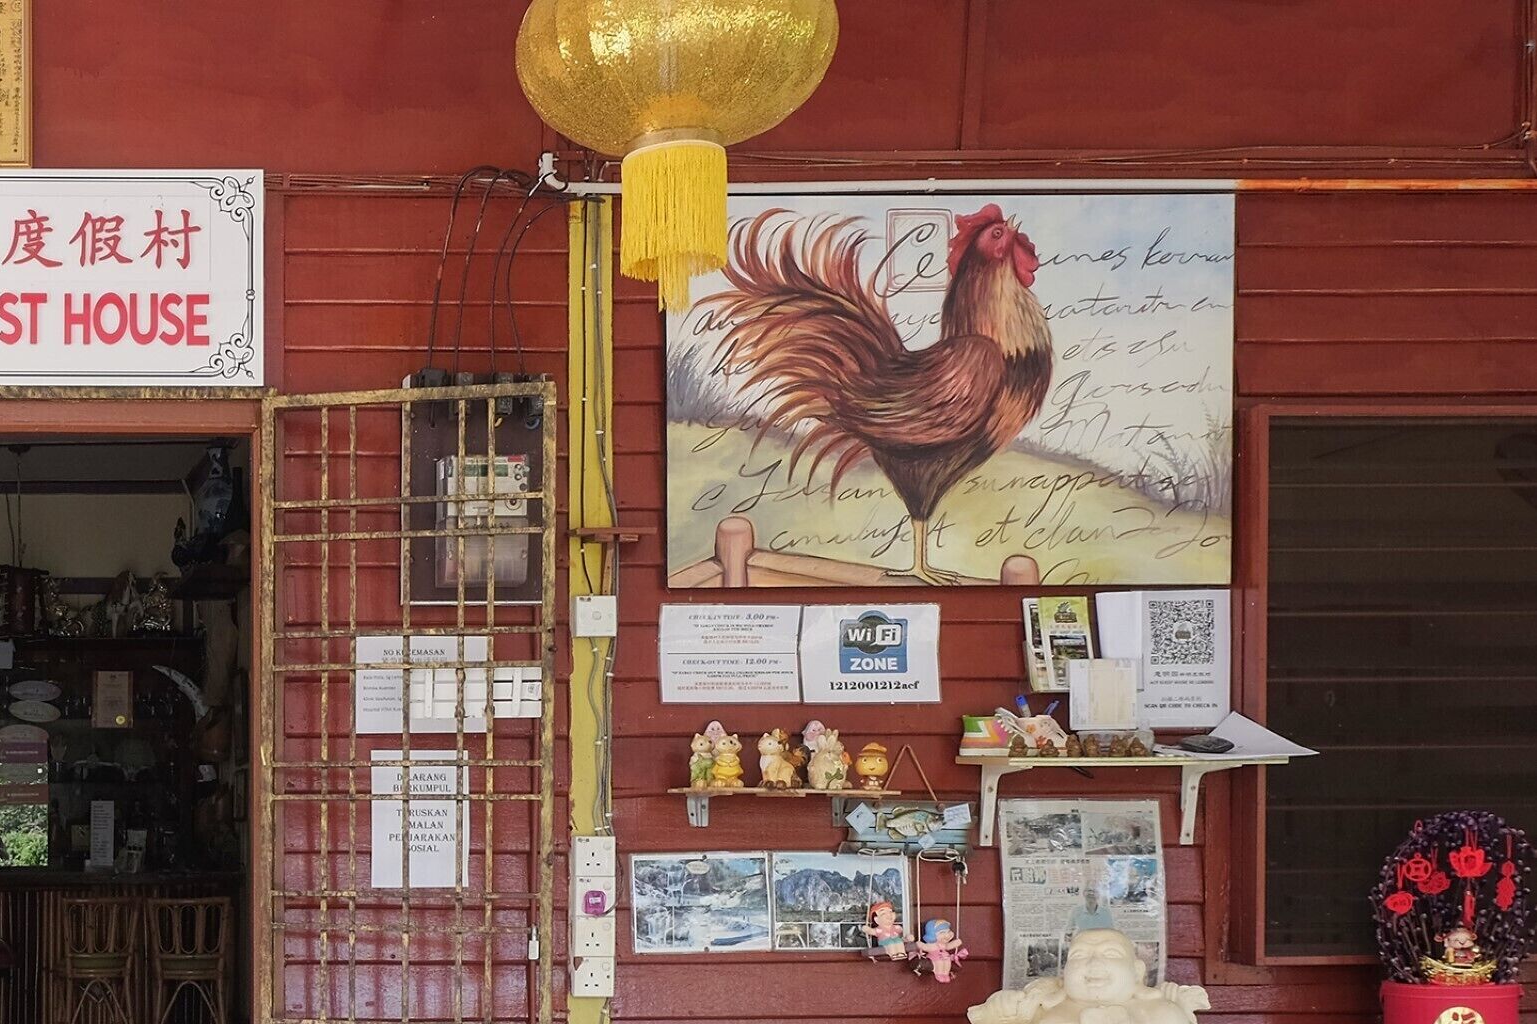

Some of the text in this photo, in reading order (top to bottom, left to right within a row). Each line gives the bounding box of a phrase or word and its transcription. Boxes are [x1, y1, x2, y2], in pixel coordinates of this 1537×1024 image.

[64, 293, 211, 346] HOUSE
[849, 657, 899, 671] ZONE
[829, 680, 920, 690] 1212001212acf
[397, 773, 447, 781] DARANG
[396, 809, 448, 817] TRUSKAN
[401, 821, 444, 829] MALAN
